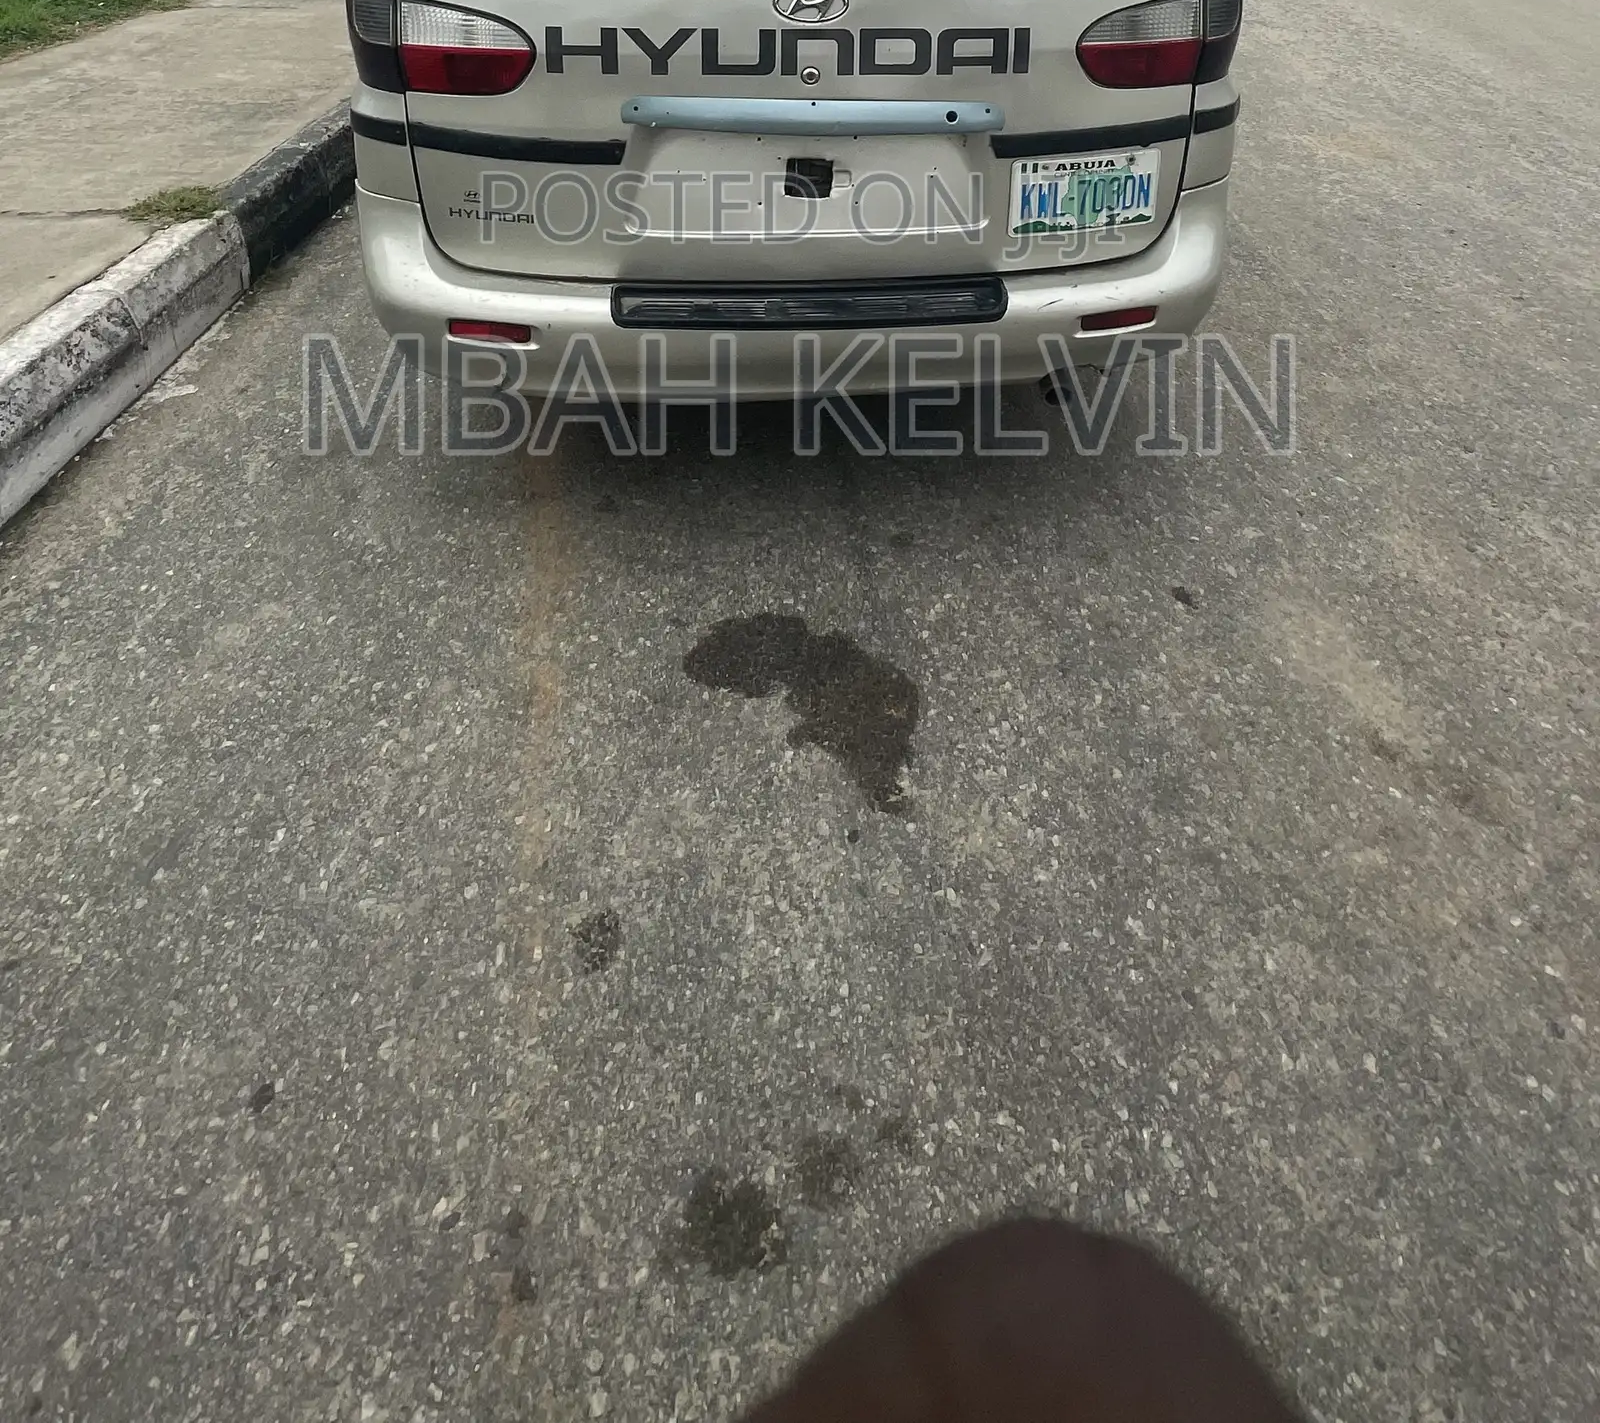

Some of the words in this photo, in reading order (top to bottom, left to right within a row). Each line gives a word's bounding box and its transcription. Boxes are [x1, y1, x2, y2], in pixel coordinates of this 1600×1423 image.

[545, 26, 1031, 76] HYUNDAI
[1055, 159, 1116, 171] ABUJA
[448, 207, 535, 224] HYUNDAI
